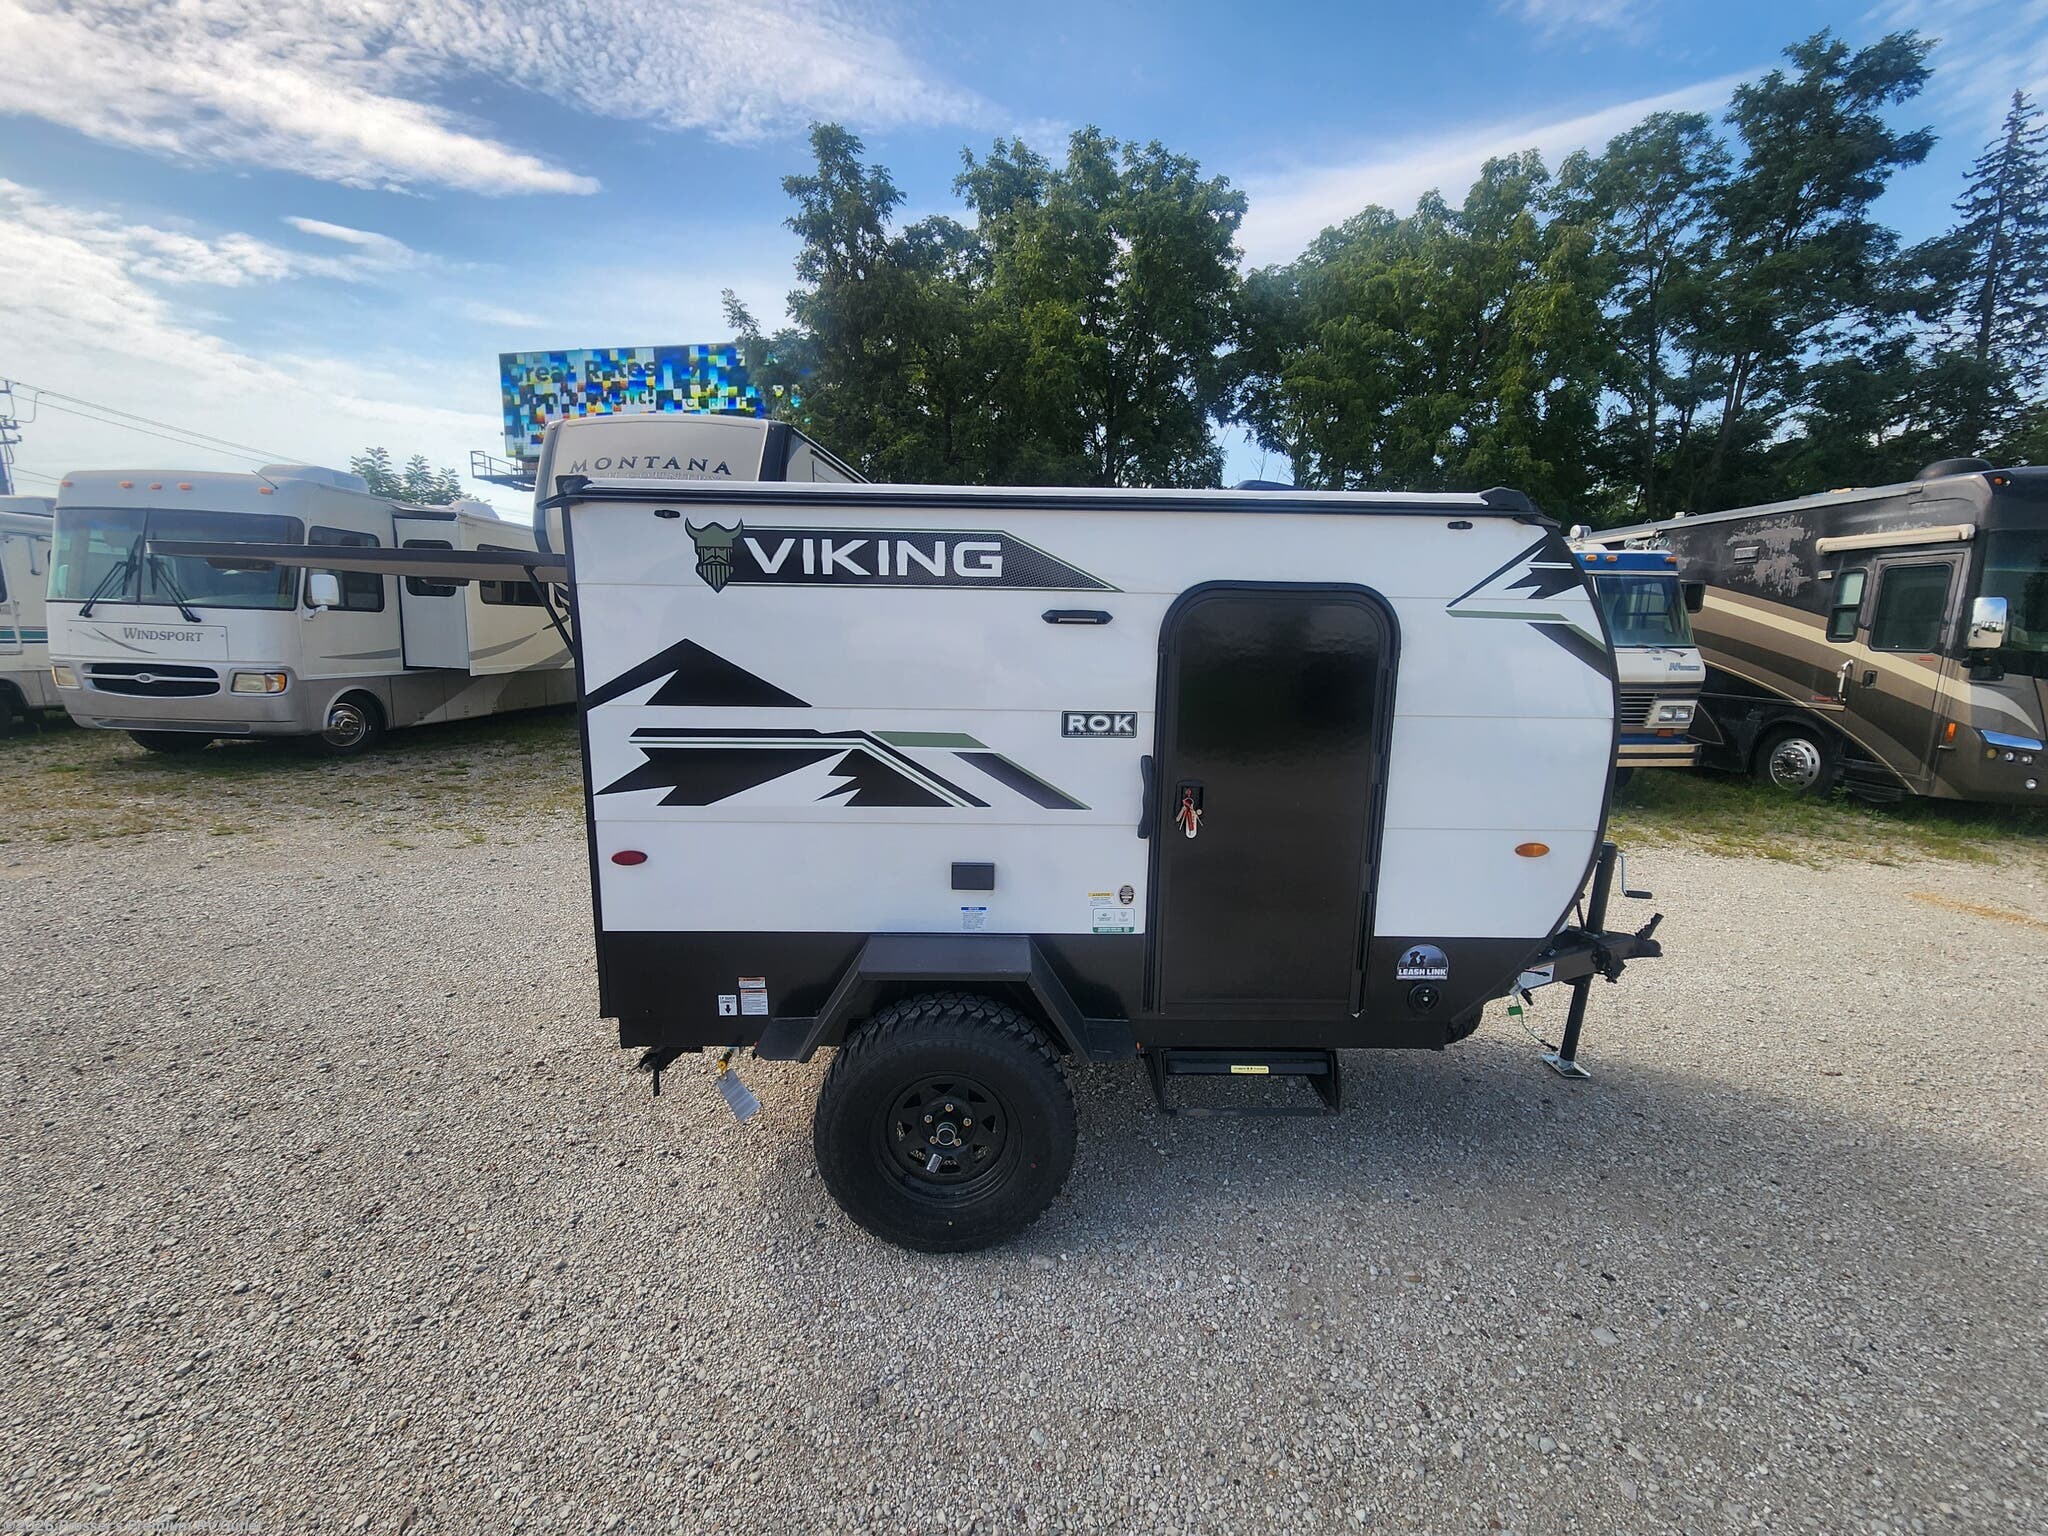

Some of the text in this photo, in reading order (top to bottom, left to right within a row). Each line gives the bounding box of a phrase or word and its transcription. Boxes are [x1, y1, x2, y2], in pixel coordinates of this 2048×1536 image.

[569, 456, 731, 475] MONTANA
[743, 537, 1003, 577] VIKING
[123, 627, 204, 642] WINDSPORT
[1067, 714, 1133, 732] ROK
[1398, 968, 1447, 976] LEASH LINK
